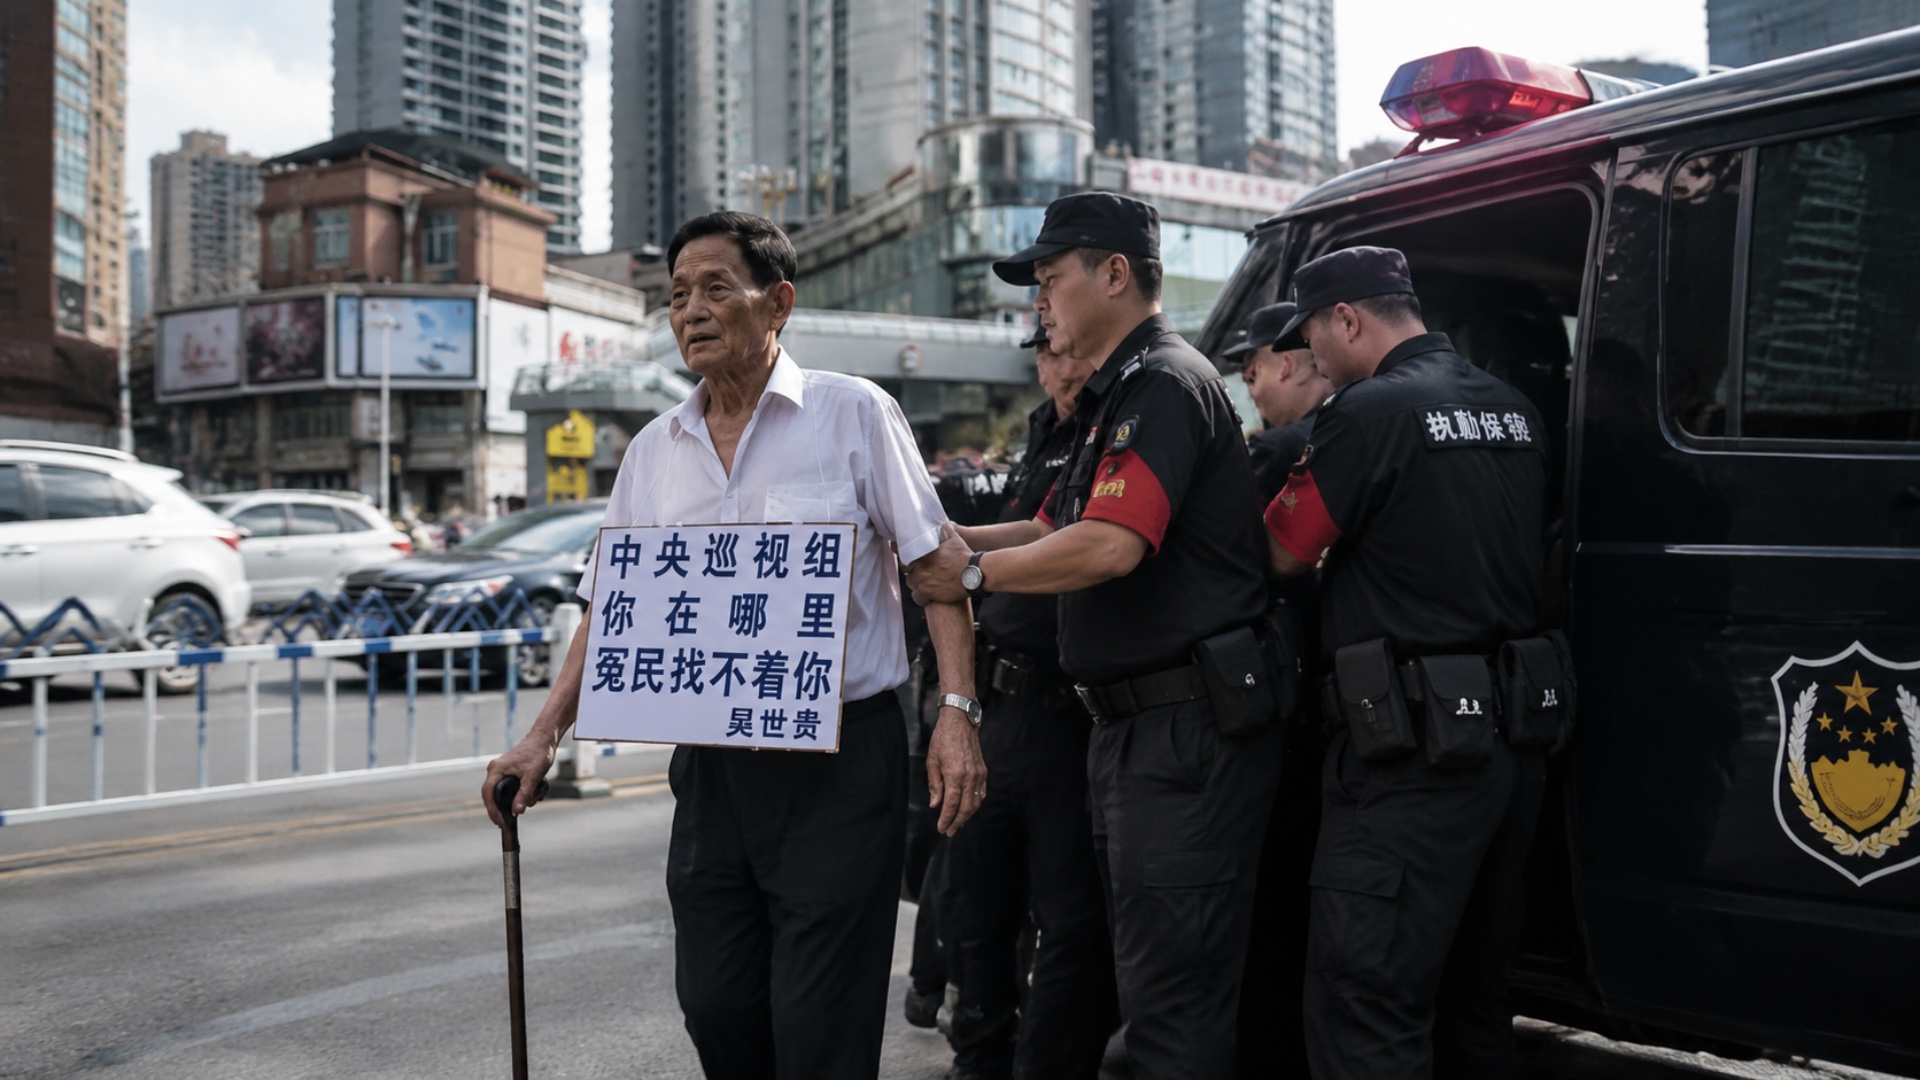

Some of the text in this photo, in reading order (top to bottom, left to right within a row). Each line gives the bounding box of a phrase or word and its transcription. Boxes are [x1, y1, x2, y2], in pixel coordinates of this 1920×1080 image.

[610, 531, 842, 580] 中央巡视组
[601, 590, 836, 639] 你在哪里
[591, 646, 833, 702] 冤民找不着你
